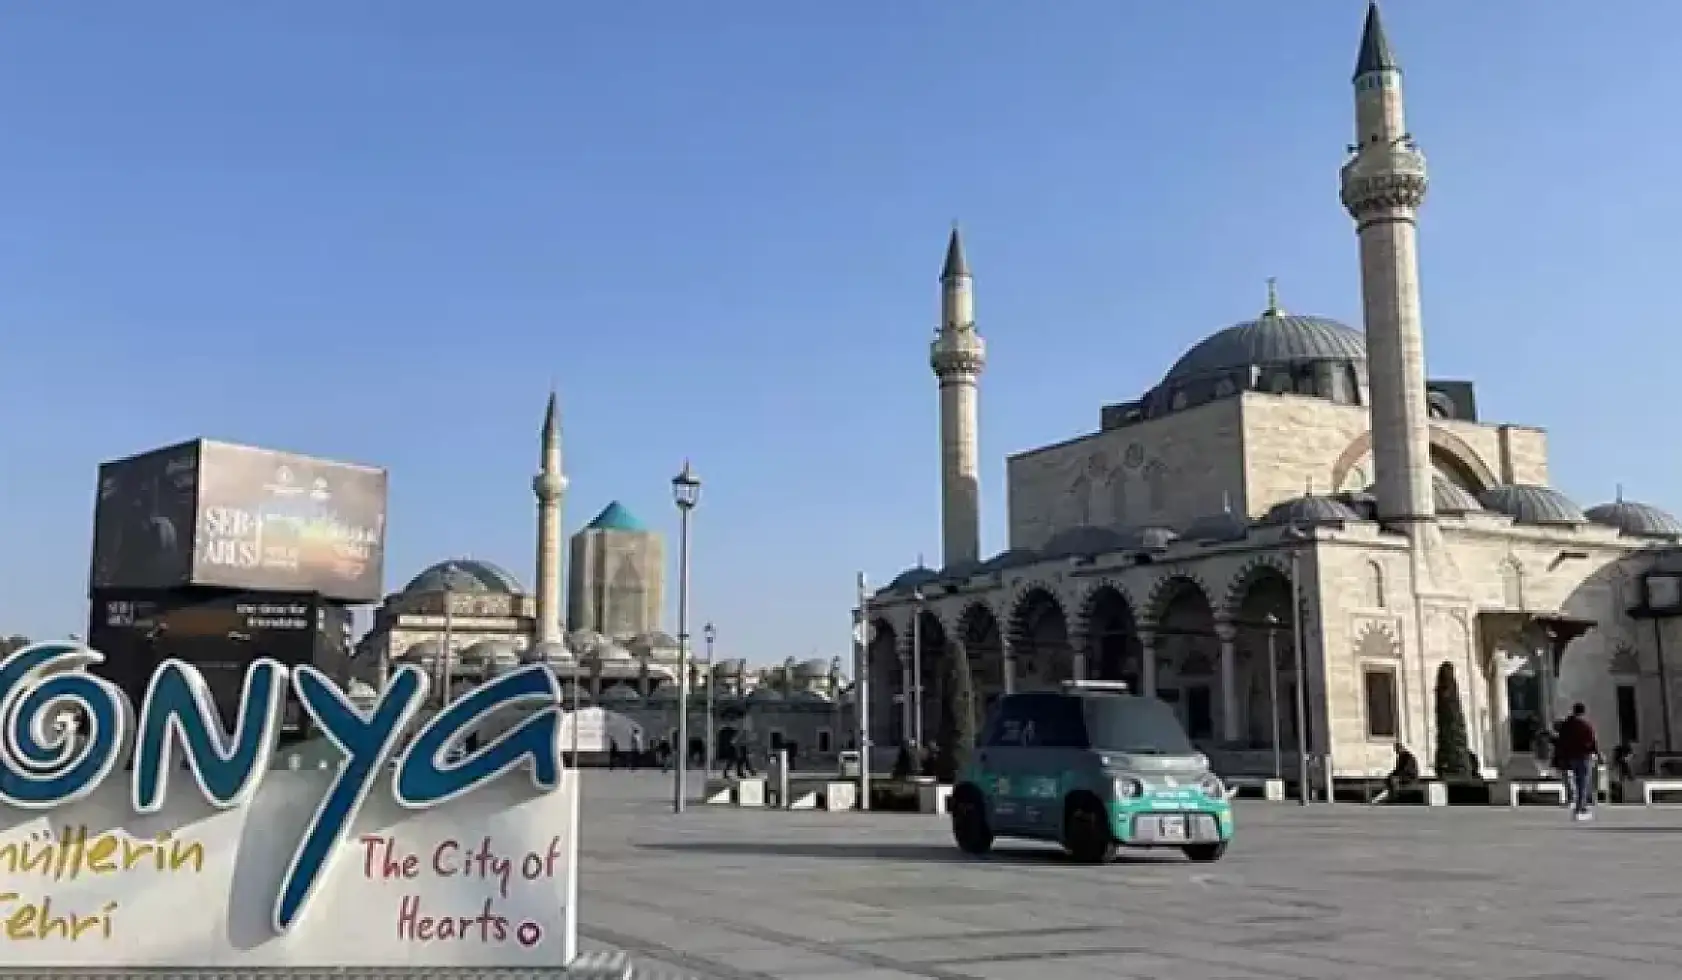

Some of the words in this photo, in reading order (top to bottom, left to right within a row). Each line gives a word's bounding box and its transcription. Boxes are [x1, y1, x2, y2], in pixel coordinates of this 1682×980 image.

[360, 836, 420, 879] The
[433, 836, 512, 898] City
[522, 836, 560, 880] of
[397, 895, 510, 943] Hearts
